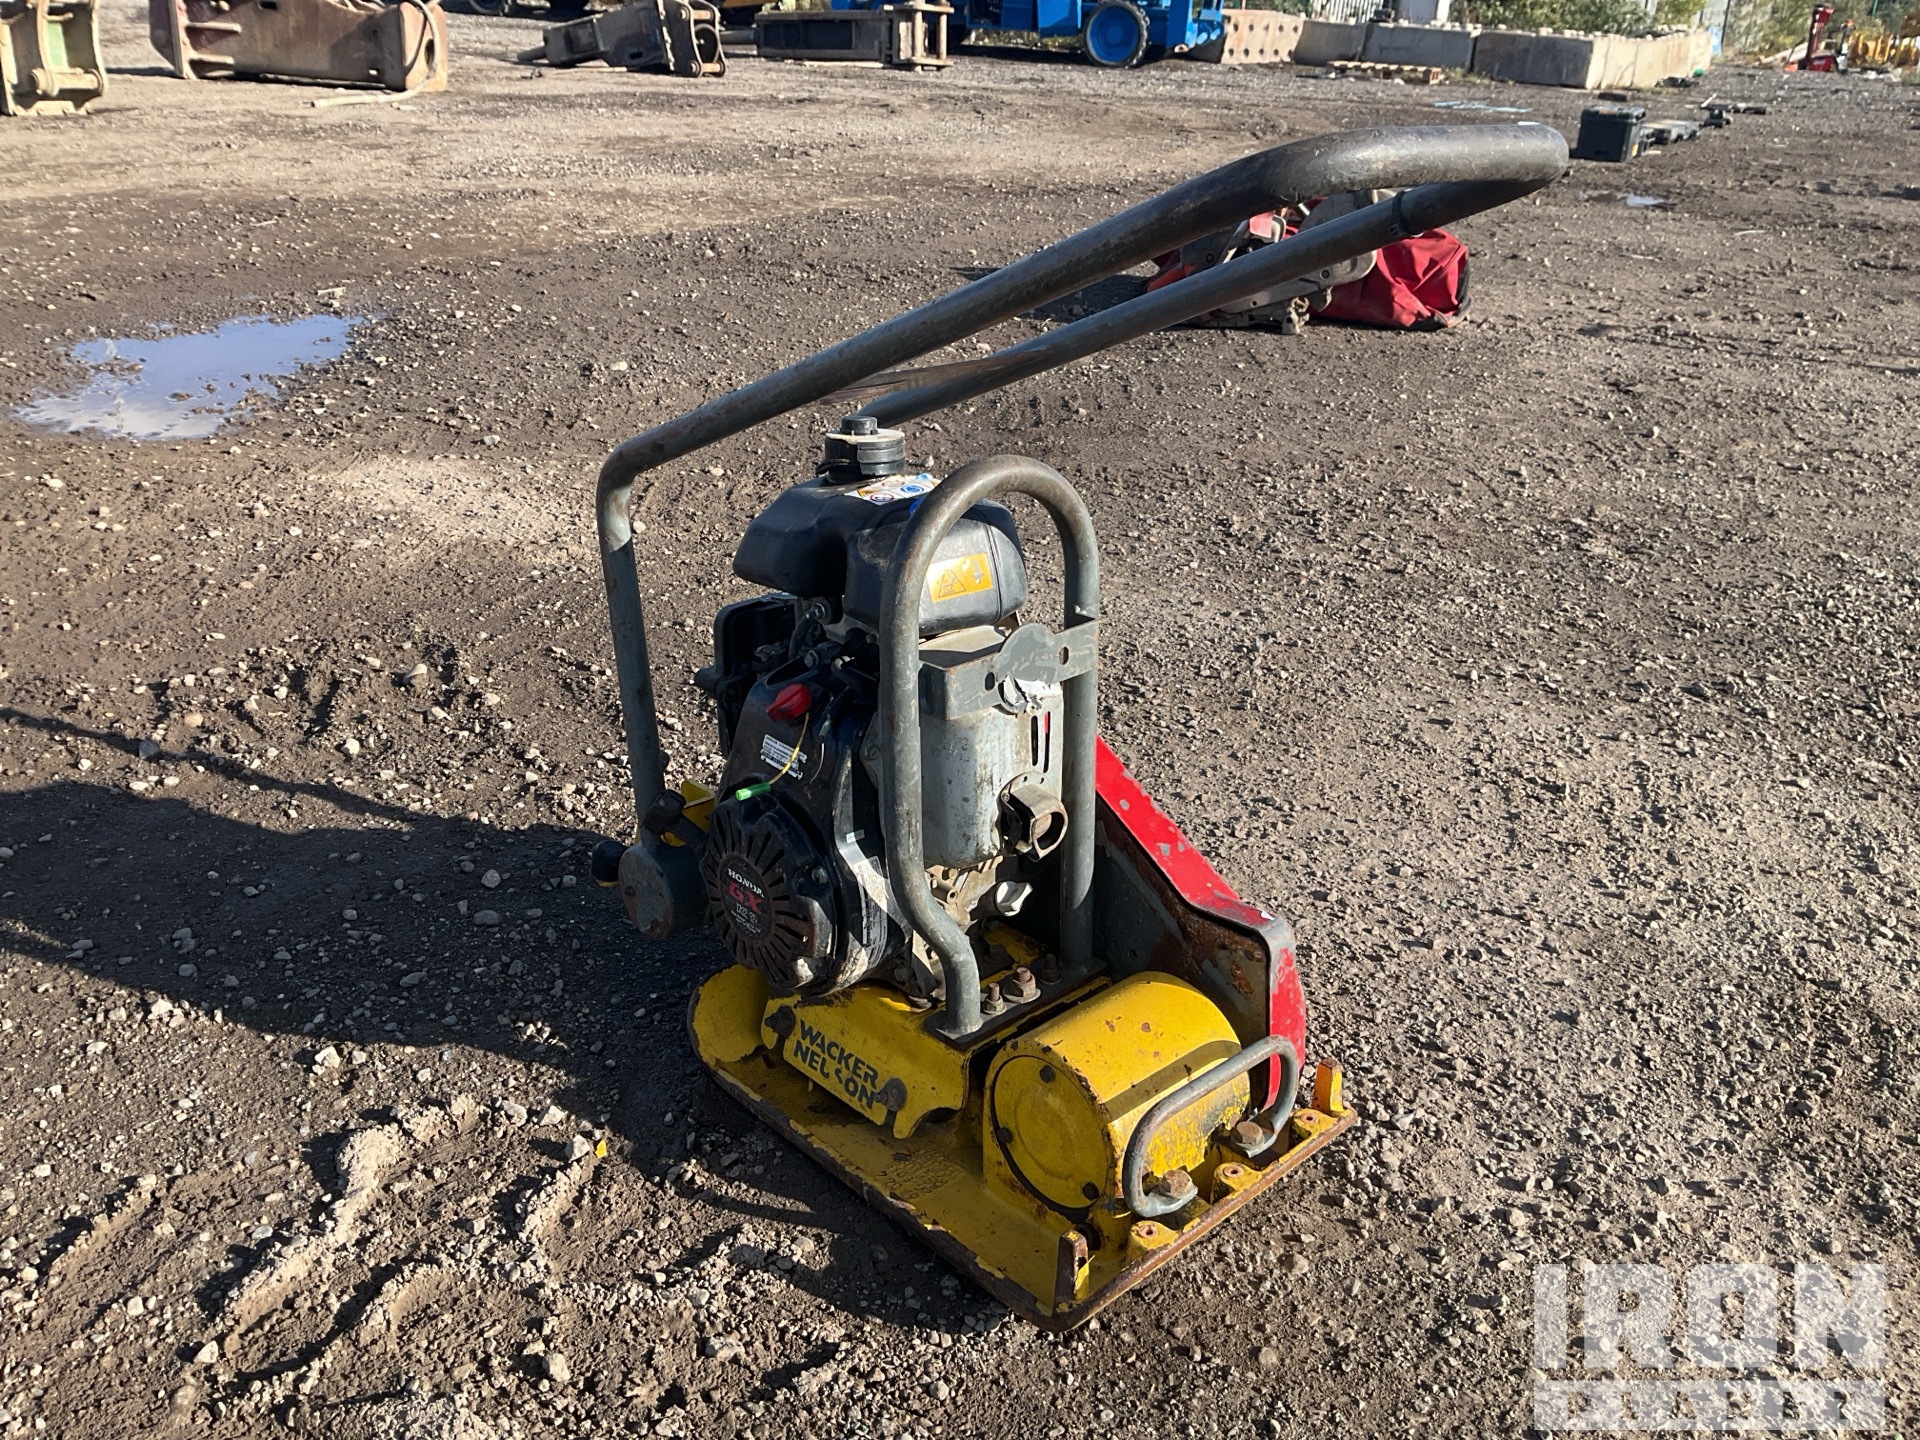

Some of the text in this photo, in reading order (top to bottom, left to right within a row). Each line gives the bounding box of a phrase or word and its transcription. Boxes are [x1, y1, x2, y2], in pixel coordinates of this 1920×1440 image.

[727, 868, 765, 898] HONDA
[728, 880, 763, 914] GX
[800, 1018, 879, 1090] WACKER
